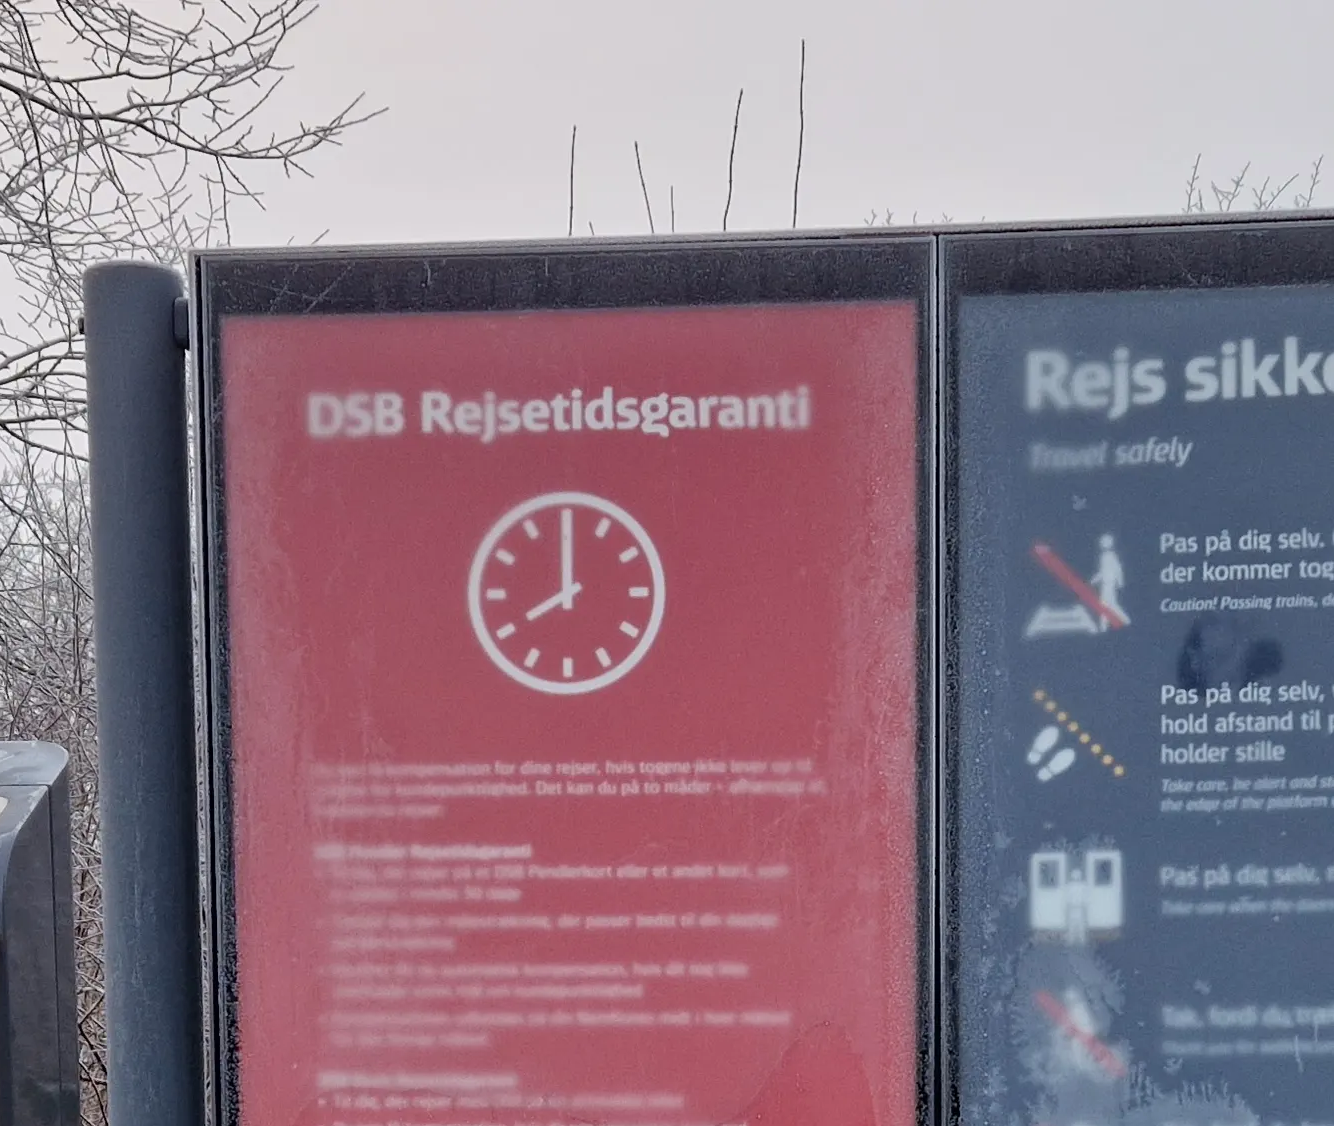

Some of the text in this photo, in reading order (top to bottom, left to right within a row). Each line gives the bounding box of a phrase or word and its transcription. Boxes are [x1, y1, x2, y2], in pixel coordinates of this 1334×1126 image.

[1025, 347, 1167, 419] Rejs
[306, 385, 812, 444] DSB Rejsetidsgaranti
[1030, 437, 1192, 470] Travel safely
[1160, 532, 1198, 555] Pas
[1205, 529, 1231, 556] på
[1238, 529, 1271, 553] dig
[1278, 528, 1325, 549] selv.
[1160, 559, 1334, 584] der kommer tog
[1160, 597, 1217, 613] Caution!
[1220, 595, 1271, 611] Passing
[1275, 593, 1318, 609] trains,
[1160, 684, 1198, 706] Pas
[1205, 681, 1231, 708] på
[1238, 681, 1271, 706] dig
[1278, 680, 1325, 703] selv,
[1160, 713, 1207, 734] hold
[1214, 710, 1293, 733] afstand
[1300, 709, 1320, 731] til
[1160, 740, 1285, 764] holder stille
[555, 761, 600, 776] rejser,
[605, 759, 634, 774] hvis
[536, 780, 561, 795] Det
[566, 780, 593, 794] kan
[598, 780, 616, 794] du
[621, 778, 641, 797] på
[643, 781, 660, 794] to
[1203, 863, 1230, 890] på
